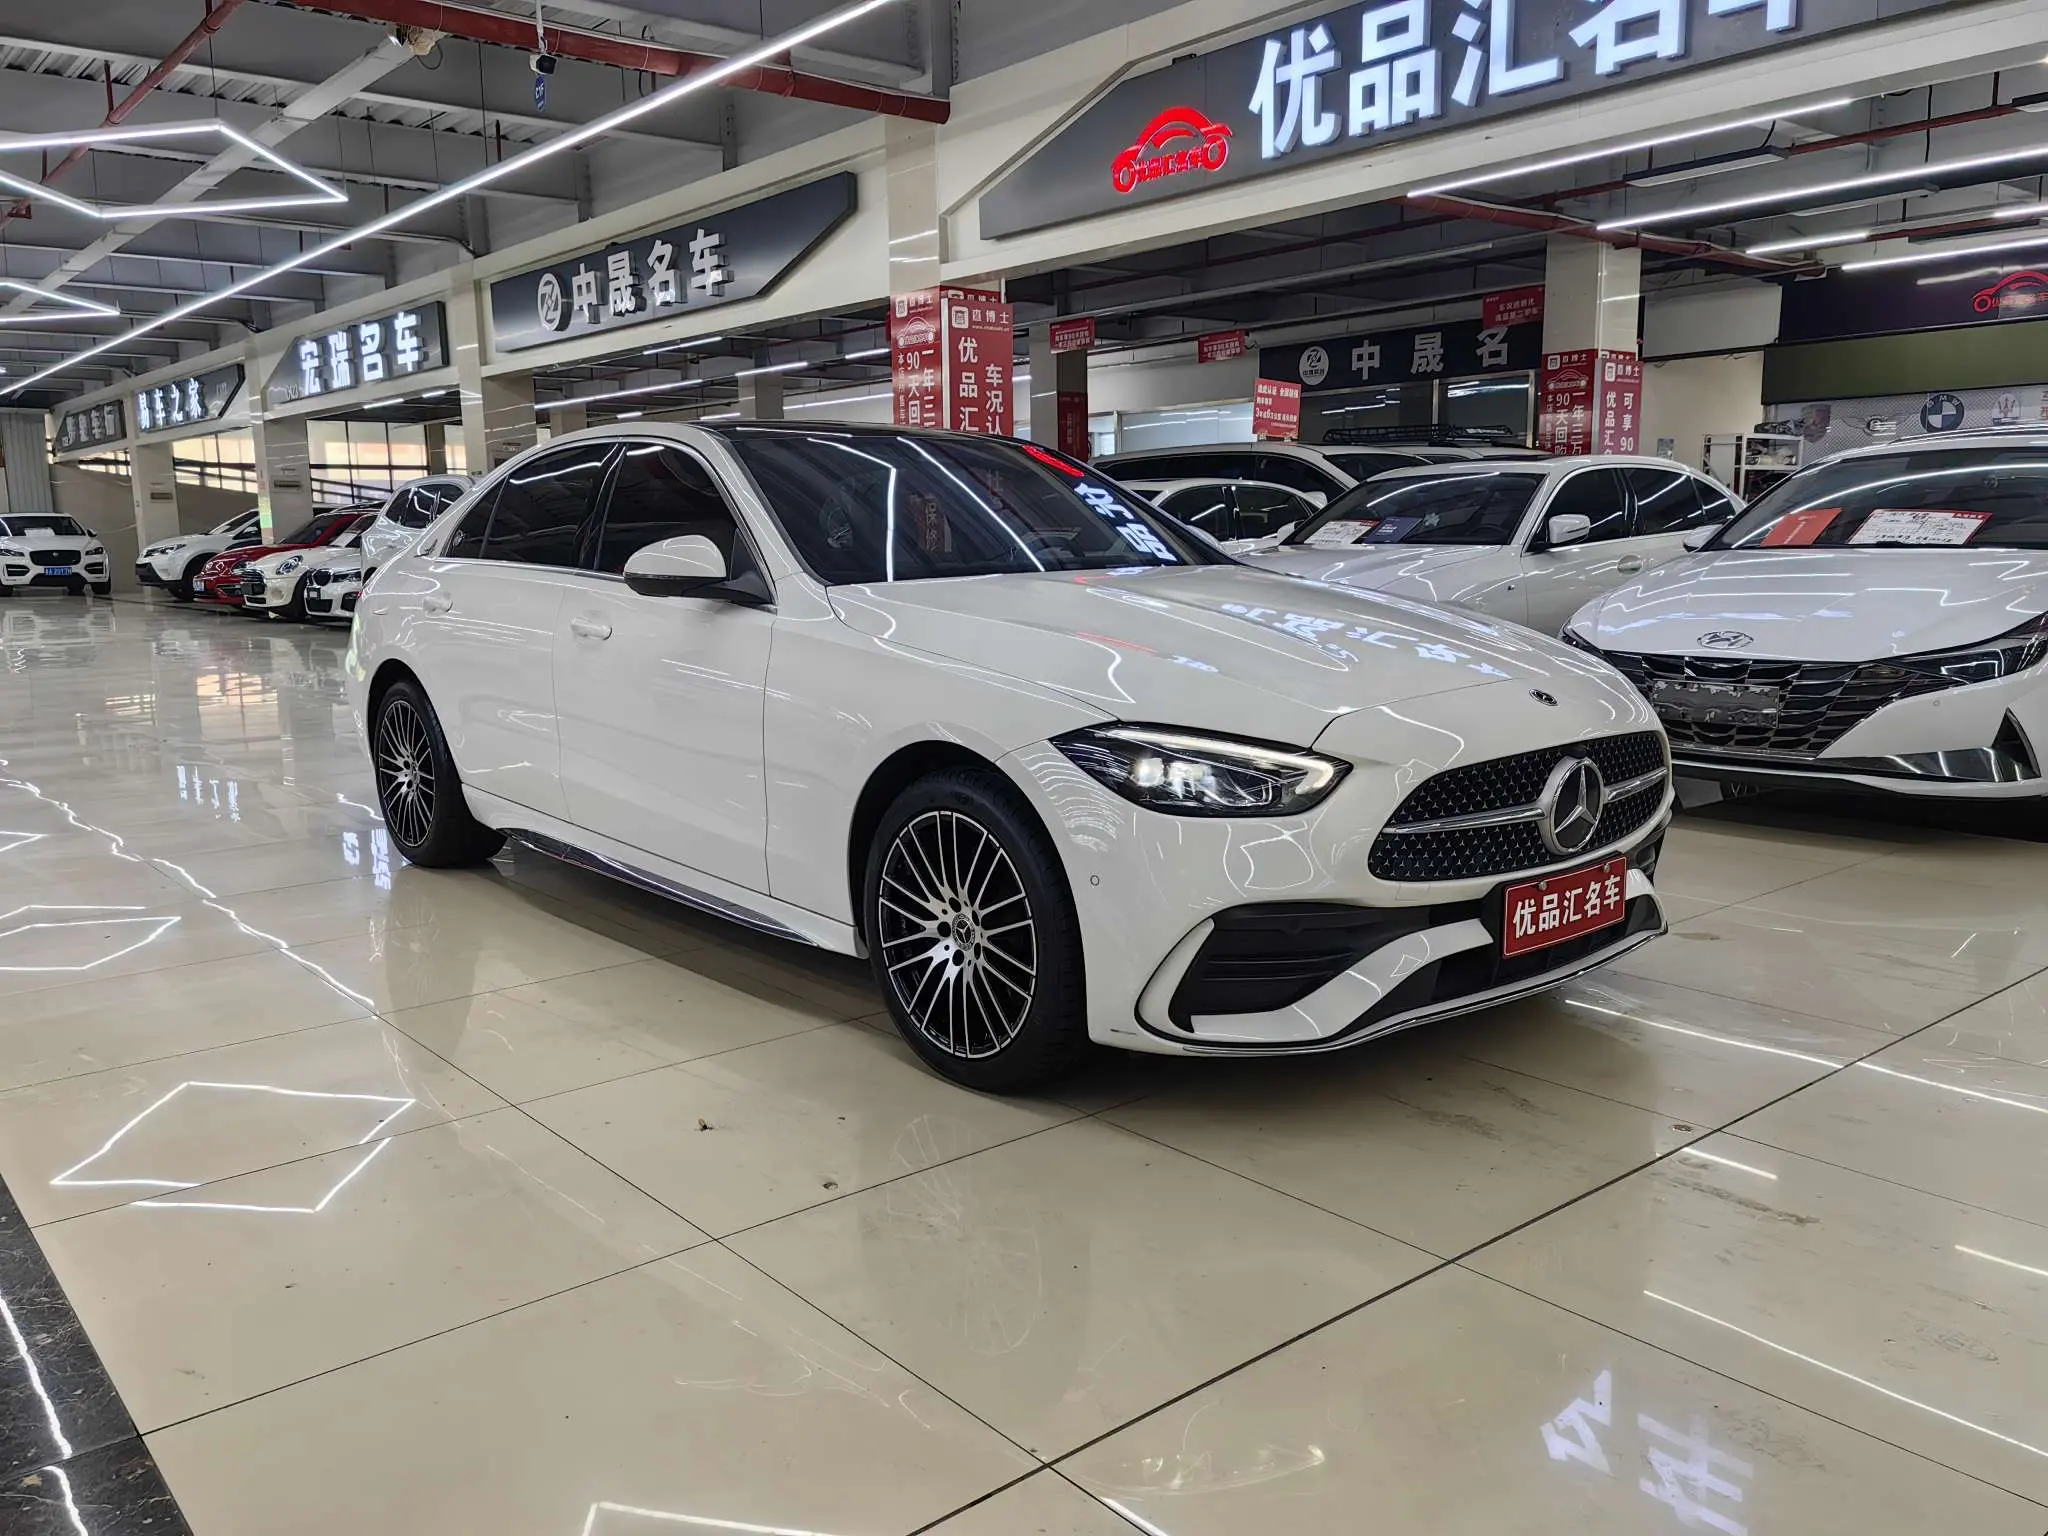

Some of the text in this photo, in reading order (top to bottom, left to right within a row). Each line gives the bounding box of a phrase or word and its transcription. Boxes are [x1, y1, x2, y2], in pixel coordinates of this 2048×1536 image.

[571, 228, 727, 324] 中晟名车
[299, 311, 419, 396] 宏瑞名车
[921, 349, 936, 426] 一年三
[958, 336, 979, 432] 优品汇
[1351, 327, 1509, 380] 中晟名
[1513, 875, 1621, 939] 优品汇名车
